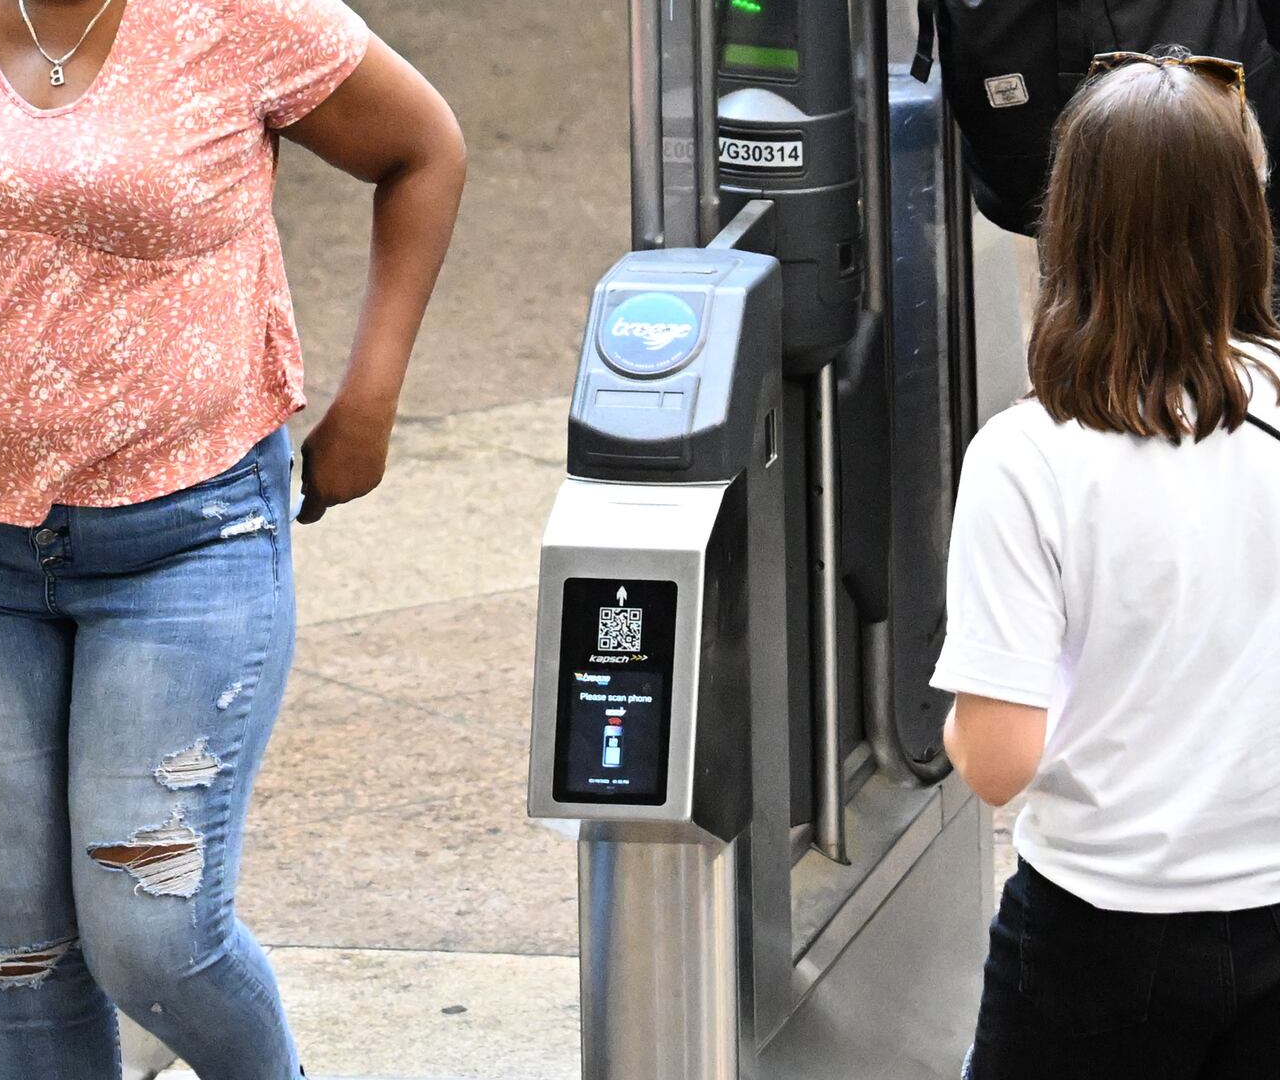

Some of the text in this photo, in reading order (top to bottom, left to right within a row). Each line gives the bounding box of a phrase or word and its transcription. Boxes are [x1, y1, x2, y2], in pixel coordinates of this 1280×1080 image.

[589, 654, 629, 663] kapsch
[580, 692, 653, 704] Please scan phone
